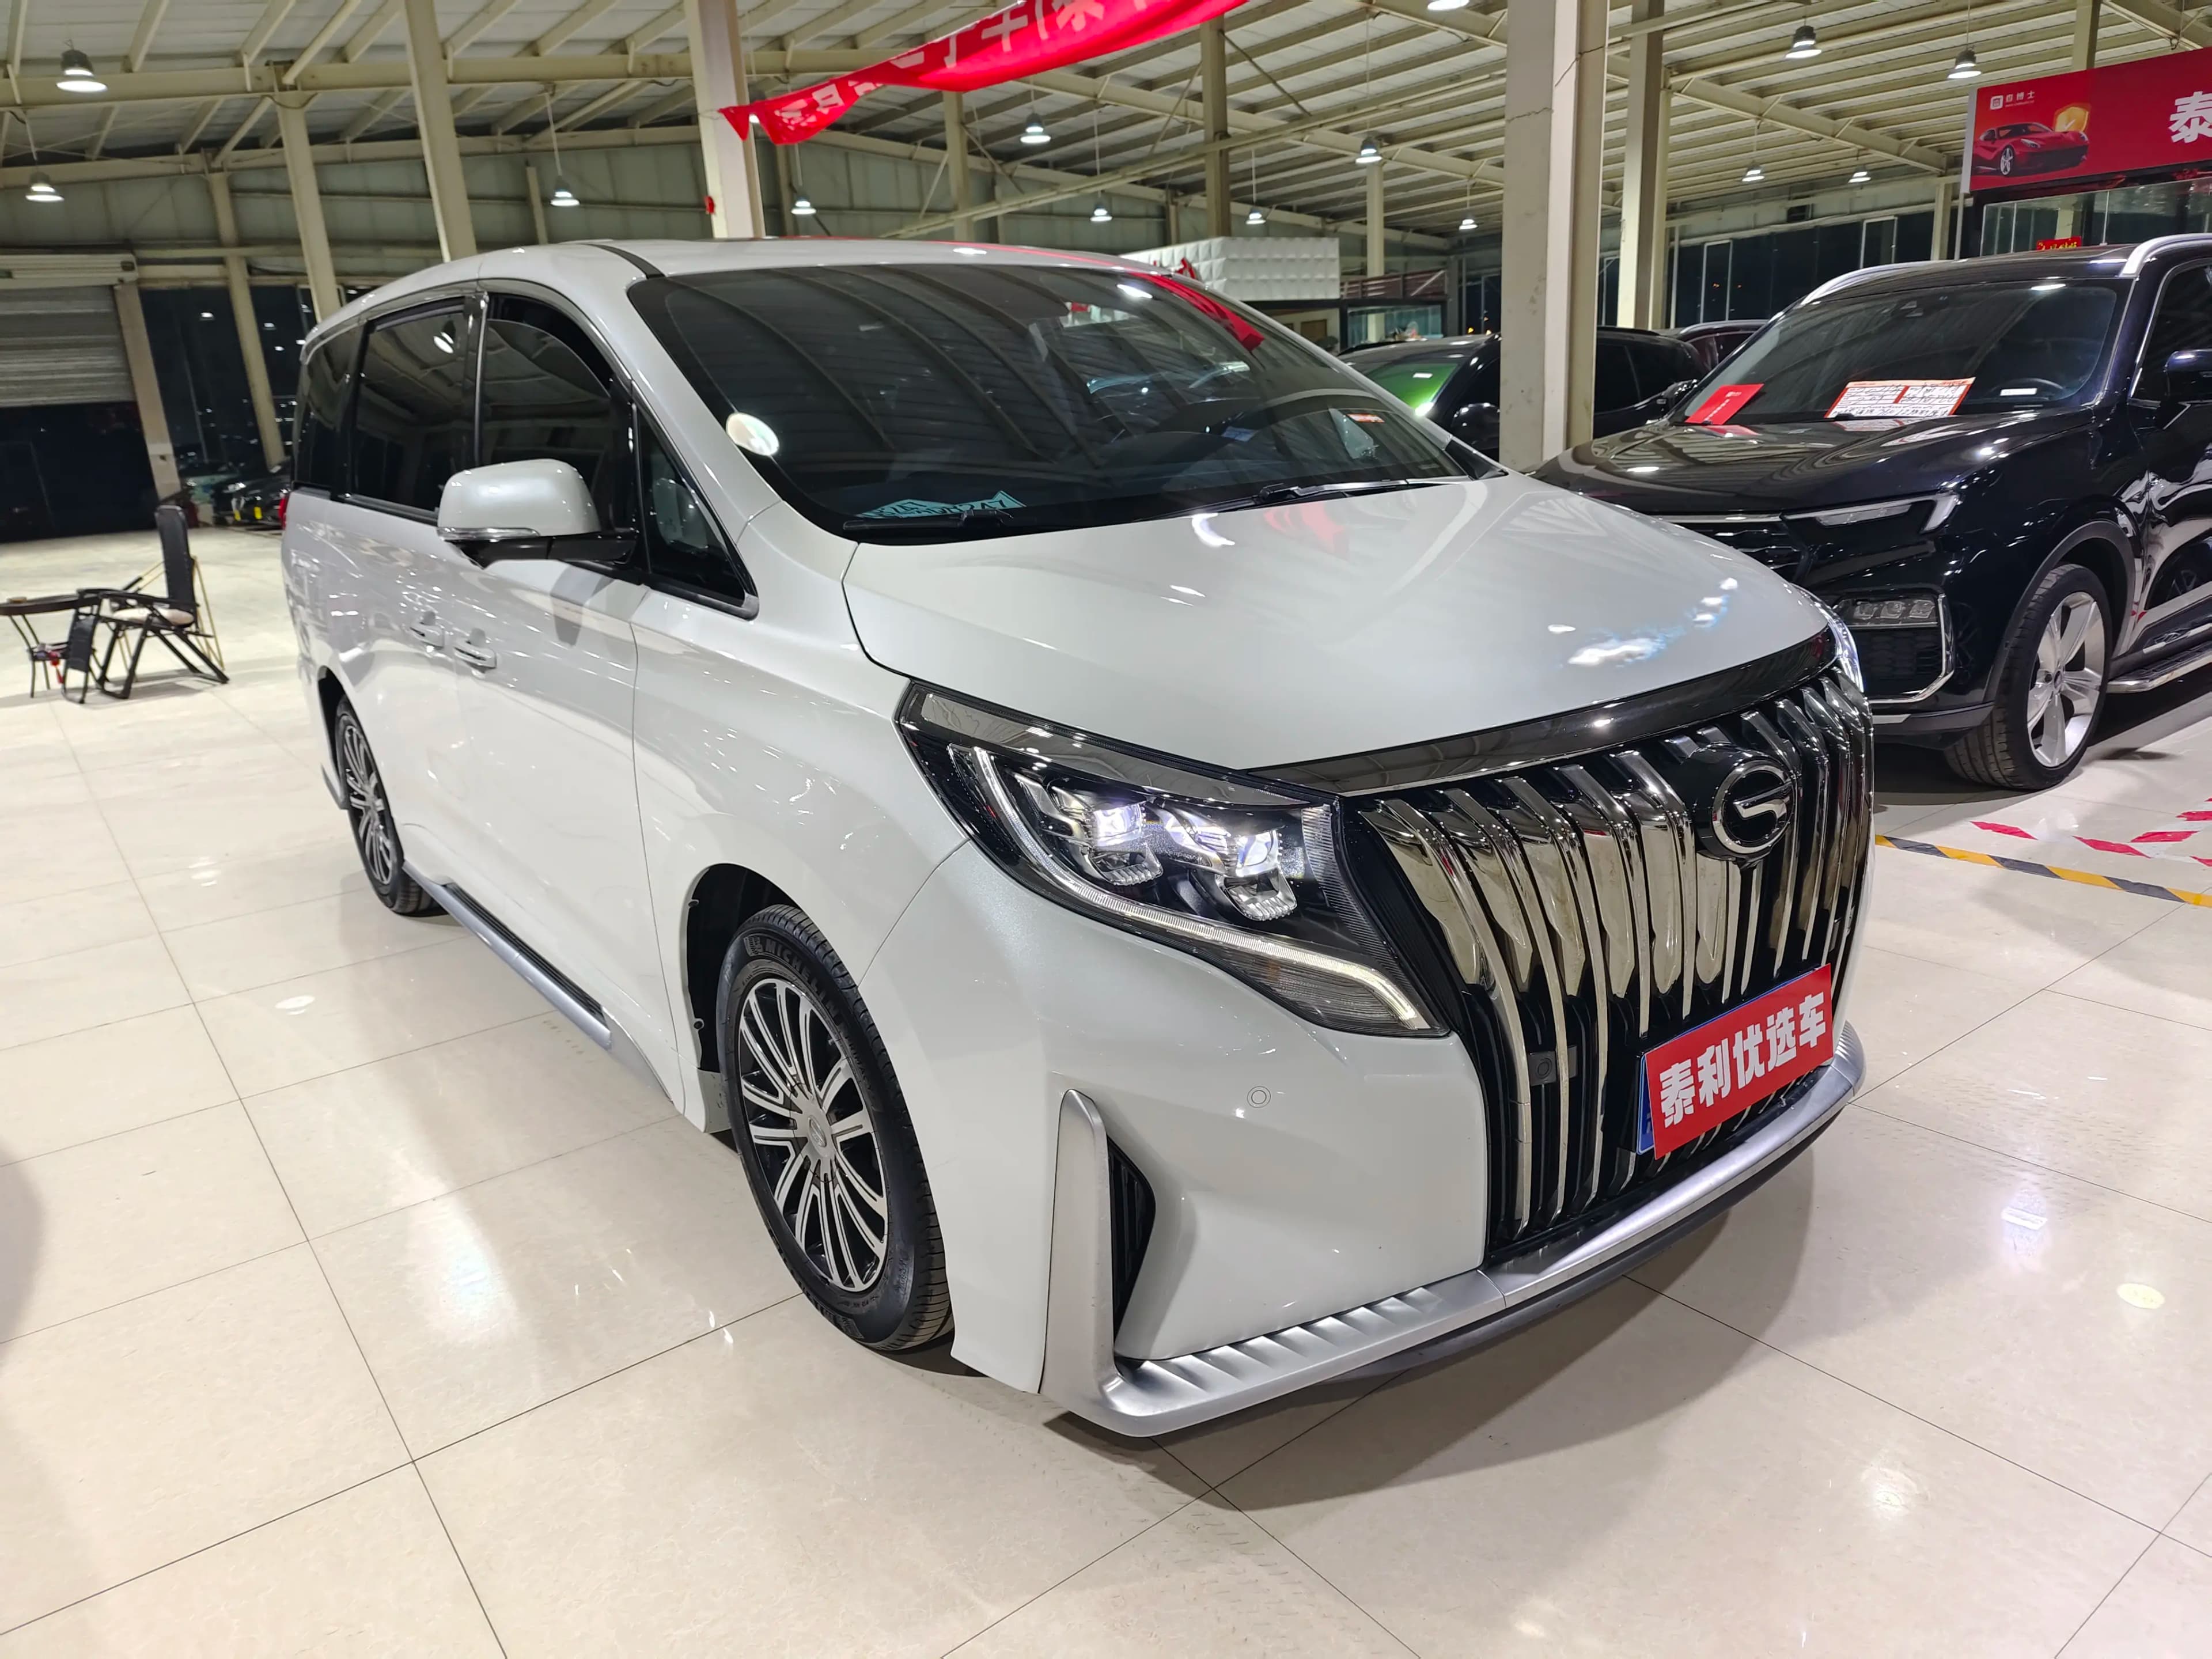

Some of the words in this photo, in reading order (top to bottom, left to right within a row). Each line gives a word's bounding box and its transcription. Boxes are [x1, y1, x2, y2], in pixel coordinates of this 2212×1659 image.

[2168, 90, 2212, 143] 泰
[766, 938, 840, 1018] MICHELIN
[1659, 991, 1827, 1129] 泰利优选车
